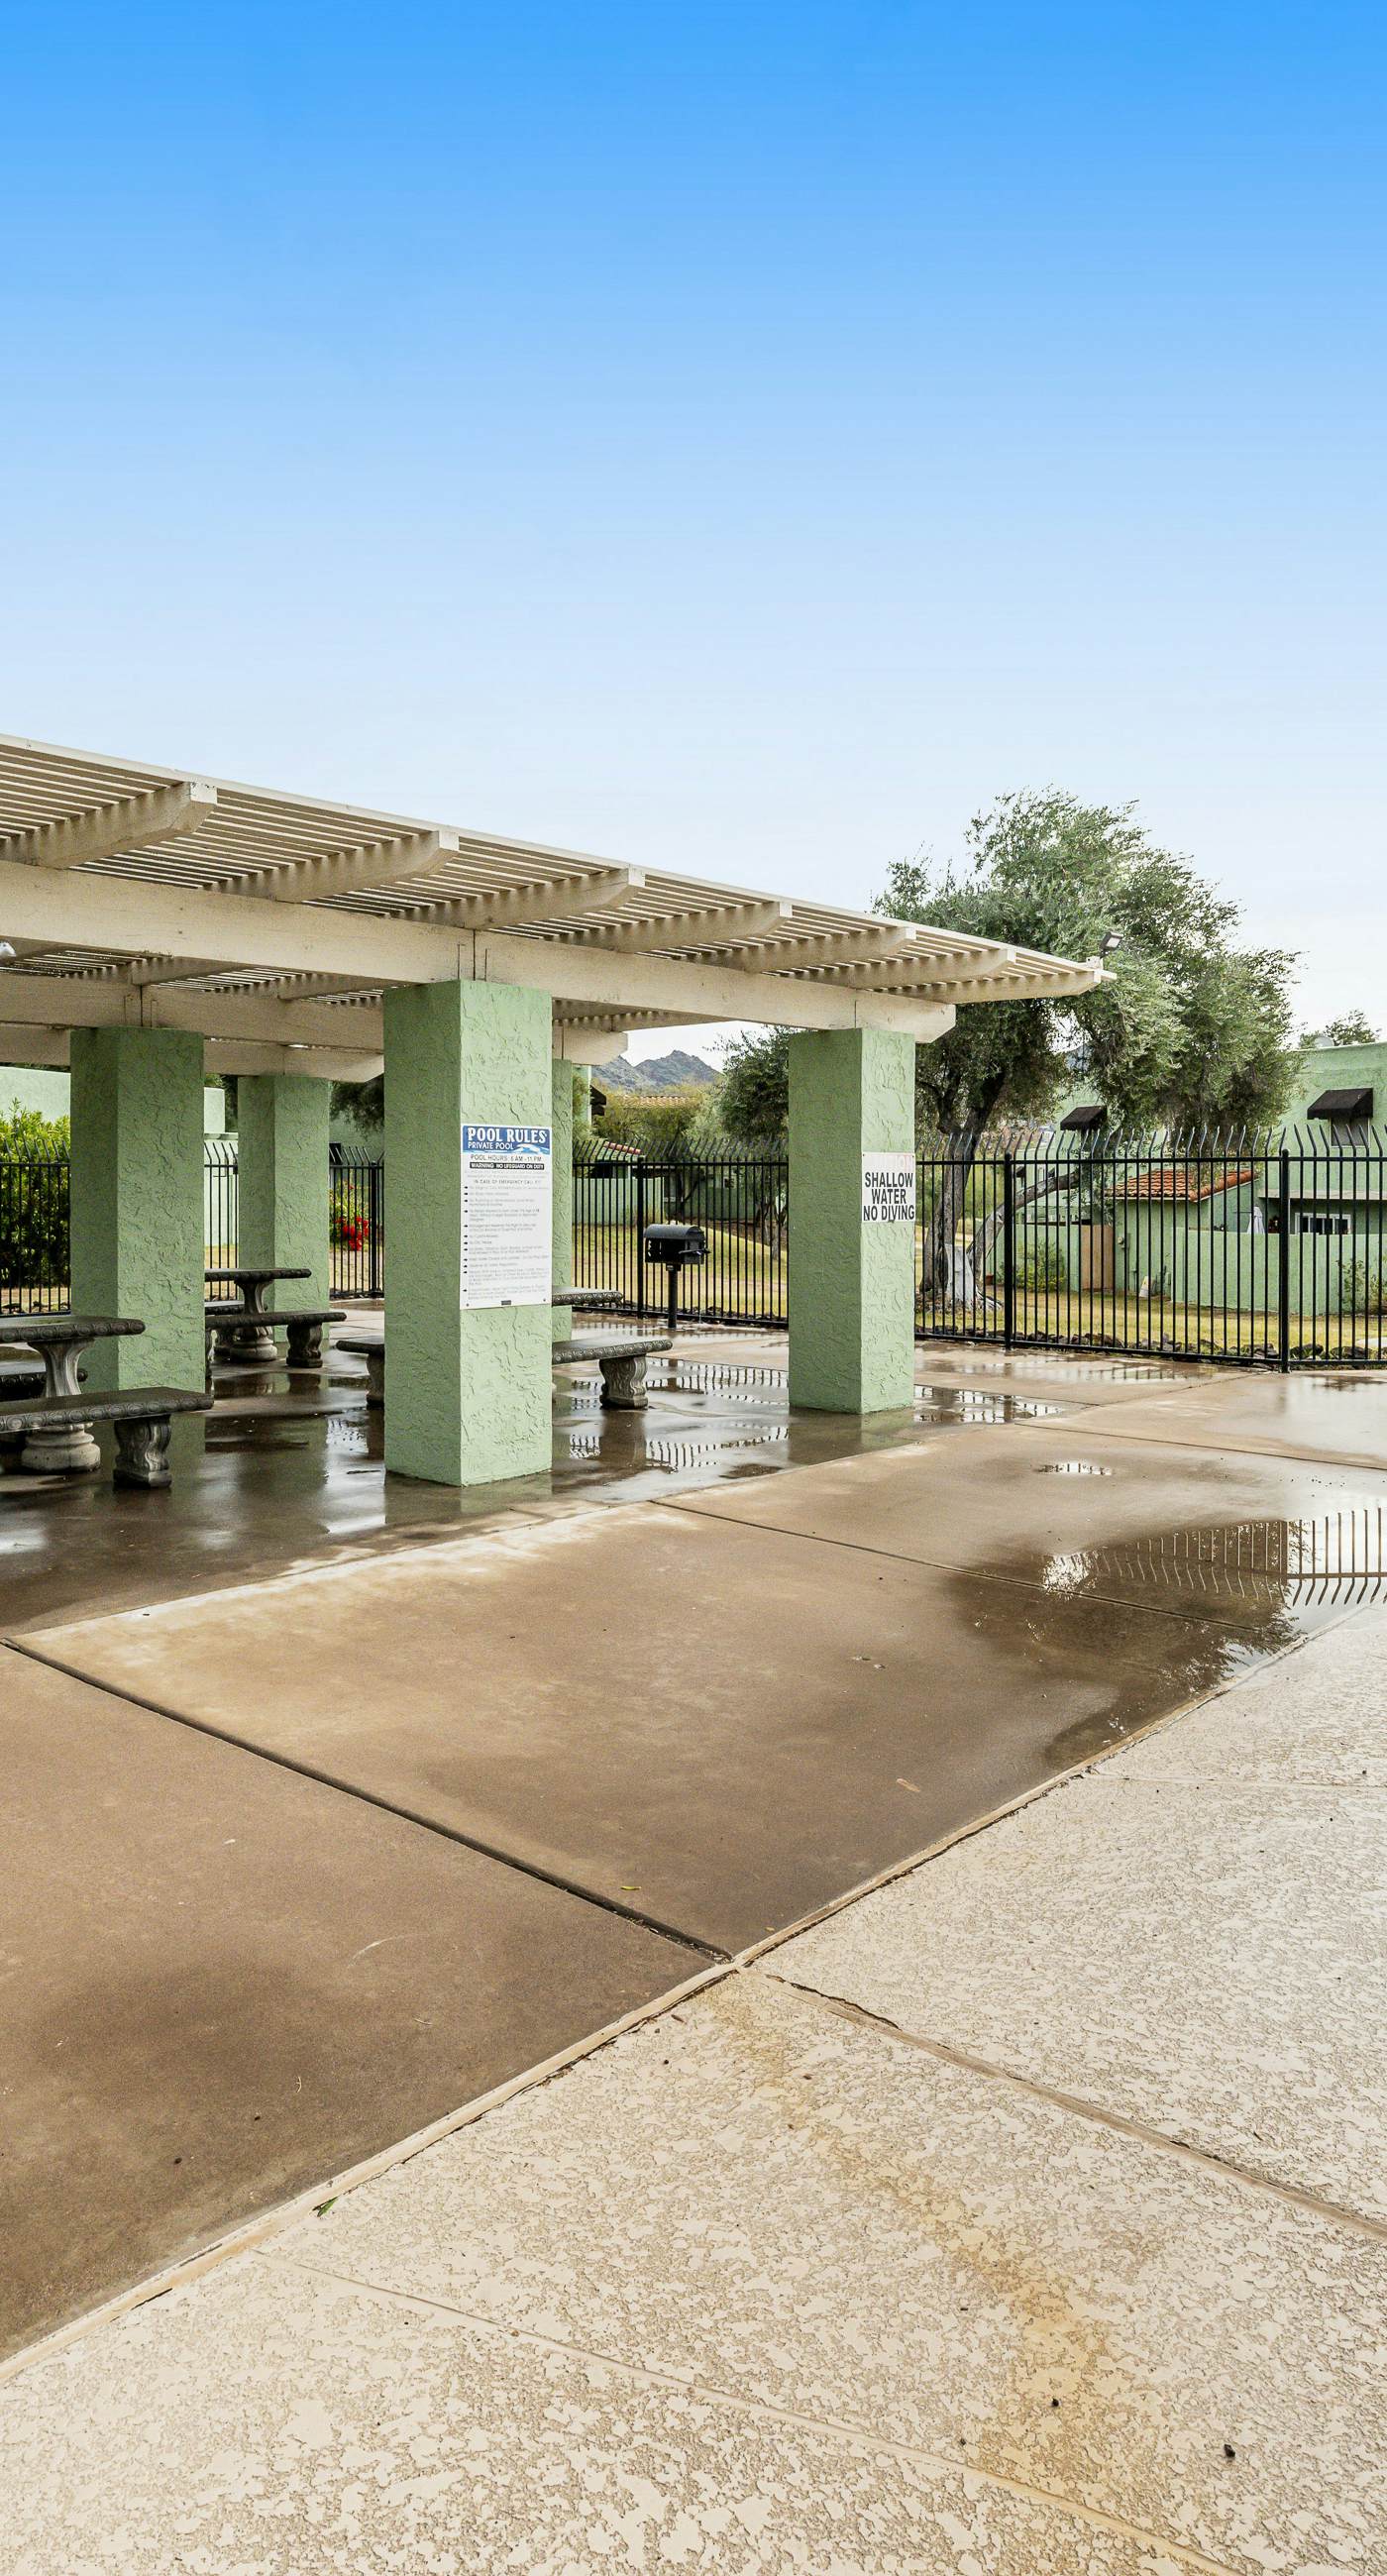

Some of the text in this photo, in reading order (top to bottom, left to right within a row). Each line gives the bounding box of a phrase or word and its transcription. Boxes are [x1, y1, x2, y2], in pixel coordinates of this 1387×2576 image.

[468, 1127, 547, 1143] POOL RULES
[865, 1172, 913, 1188] SHALLOW
[871, 1189, 907, 1204] WATER
[863, 1205, 914, 1221] NO DIVING
